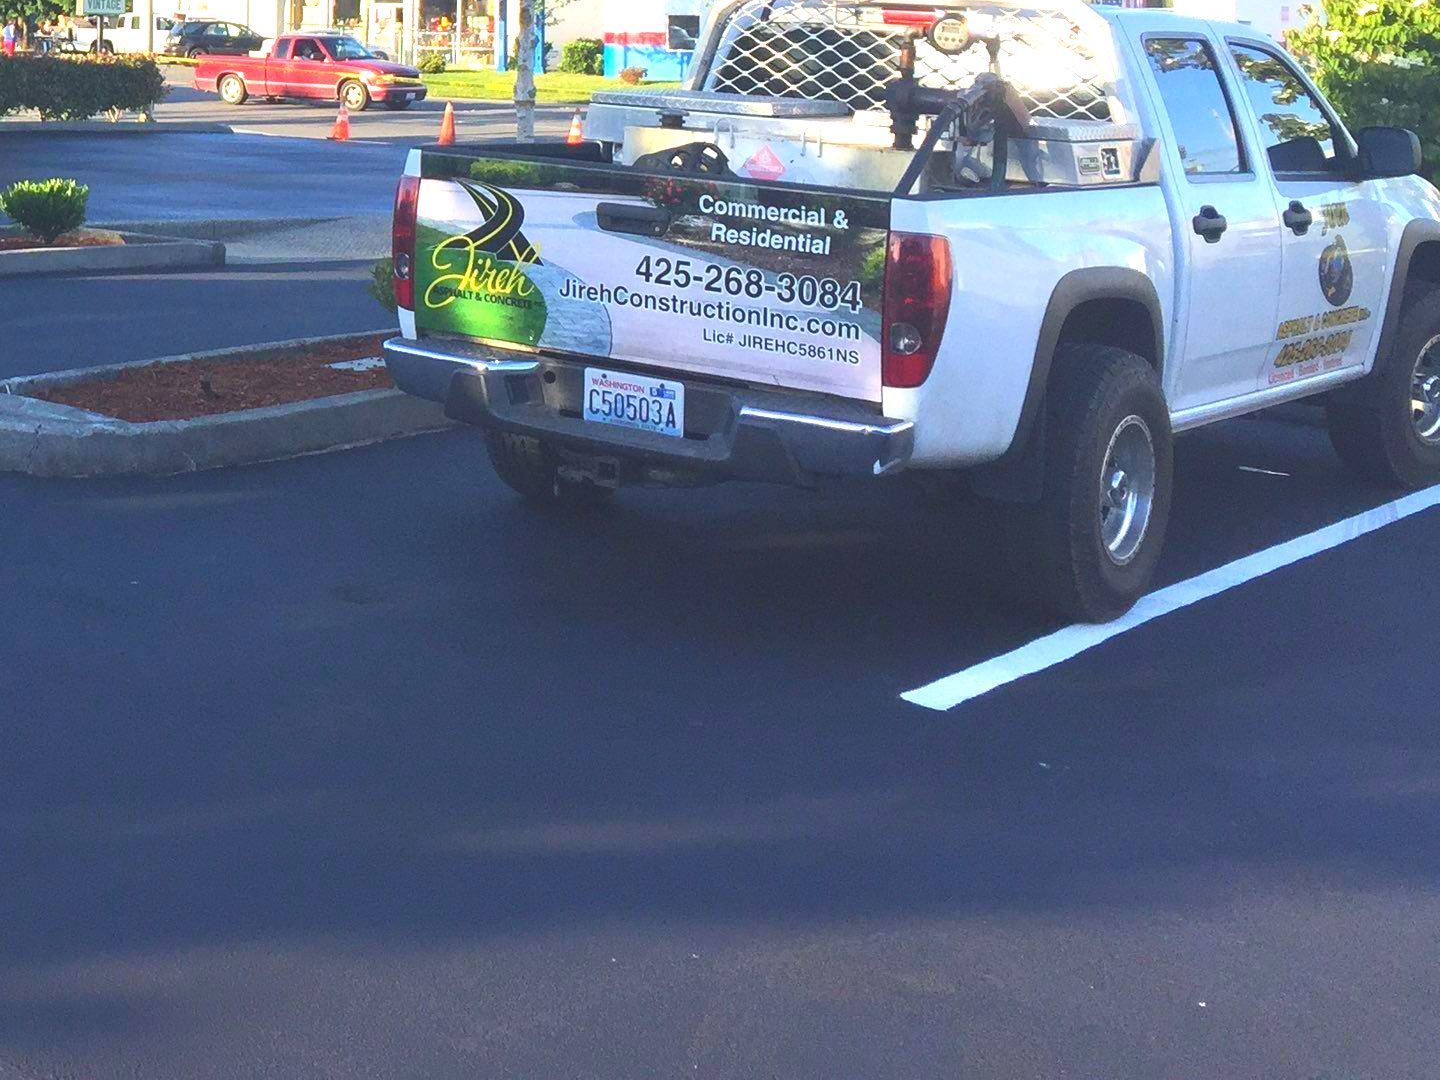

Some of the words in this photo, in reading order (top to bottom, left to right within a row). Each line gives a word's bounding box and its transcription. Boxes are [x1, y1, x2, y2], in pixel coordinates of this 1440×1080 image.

[699, 194, 826, 227] Commercial
[832, 209, 849, 230] &
[711, 223, 831, 255] Residential
[425, 235, 541, 308] Jireh
[635, 255, 862, 312] 425-268-3084
[476, 291, 483, 302] &
[485, 292, 532, 310] CONCRETE
[559, 279, 860, 340] JirehConstructionInc.com
[702, 328, 734, 345] Lic#
[592, 377, 645, 394] WASHINGTON
[589, 388, 676, 429] C50503A
